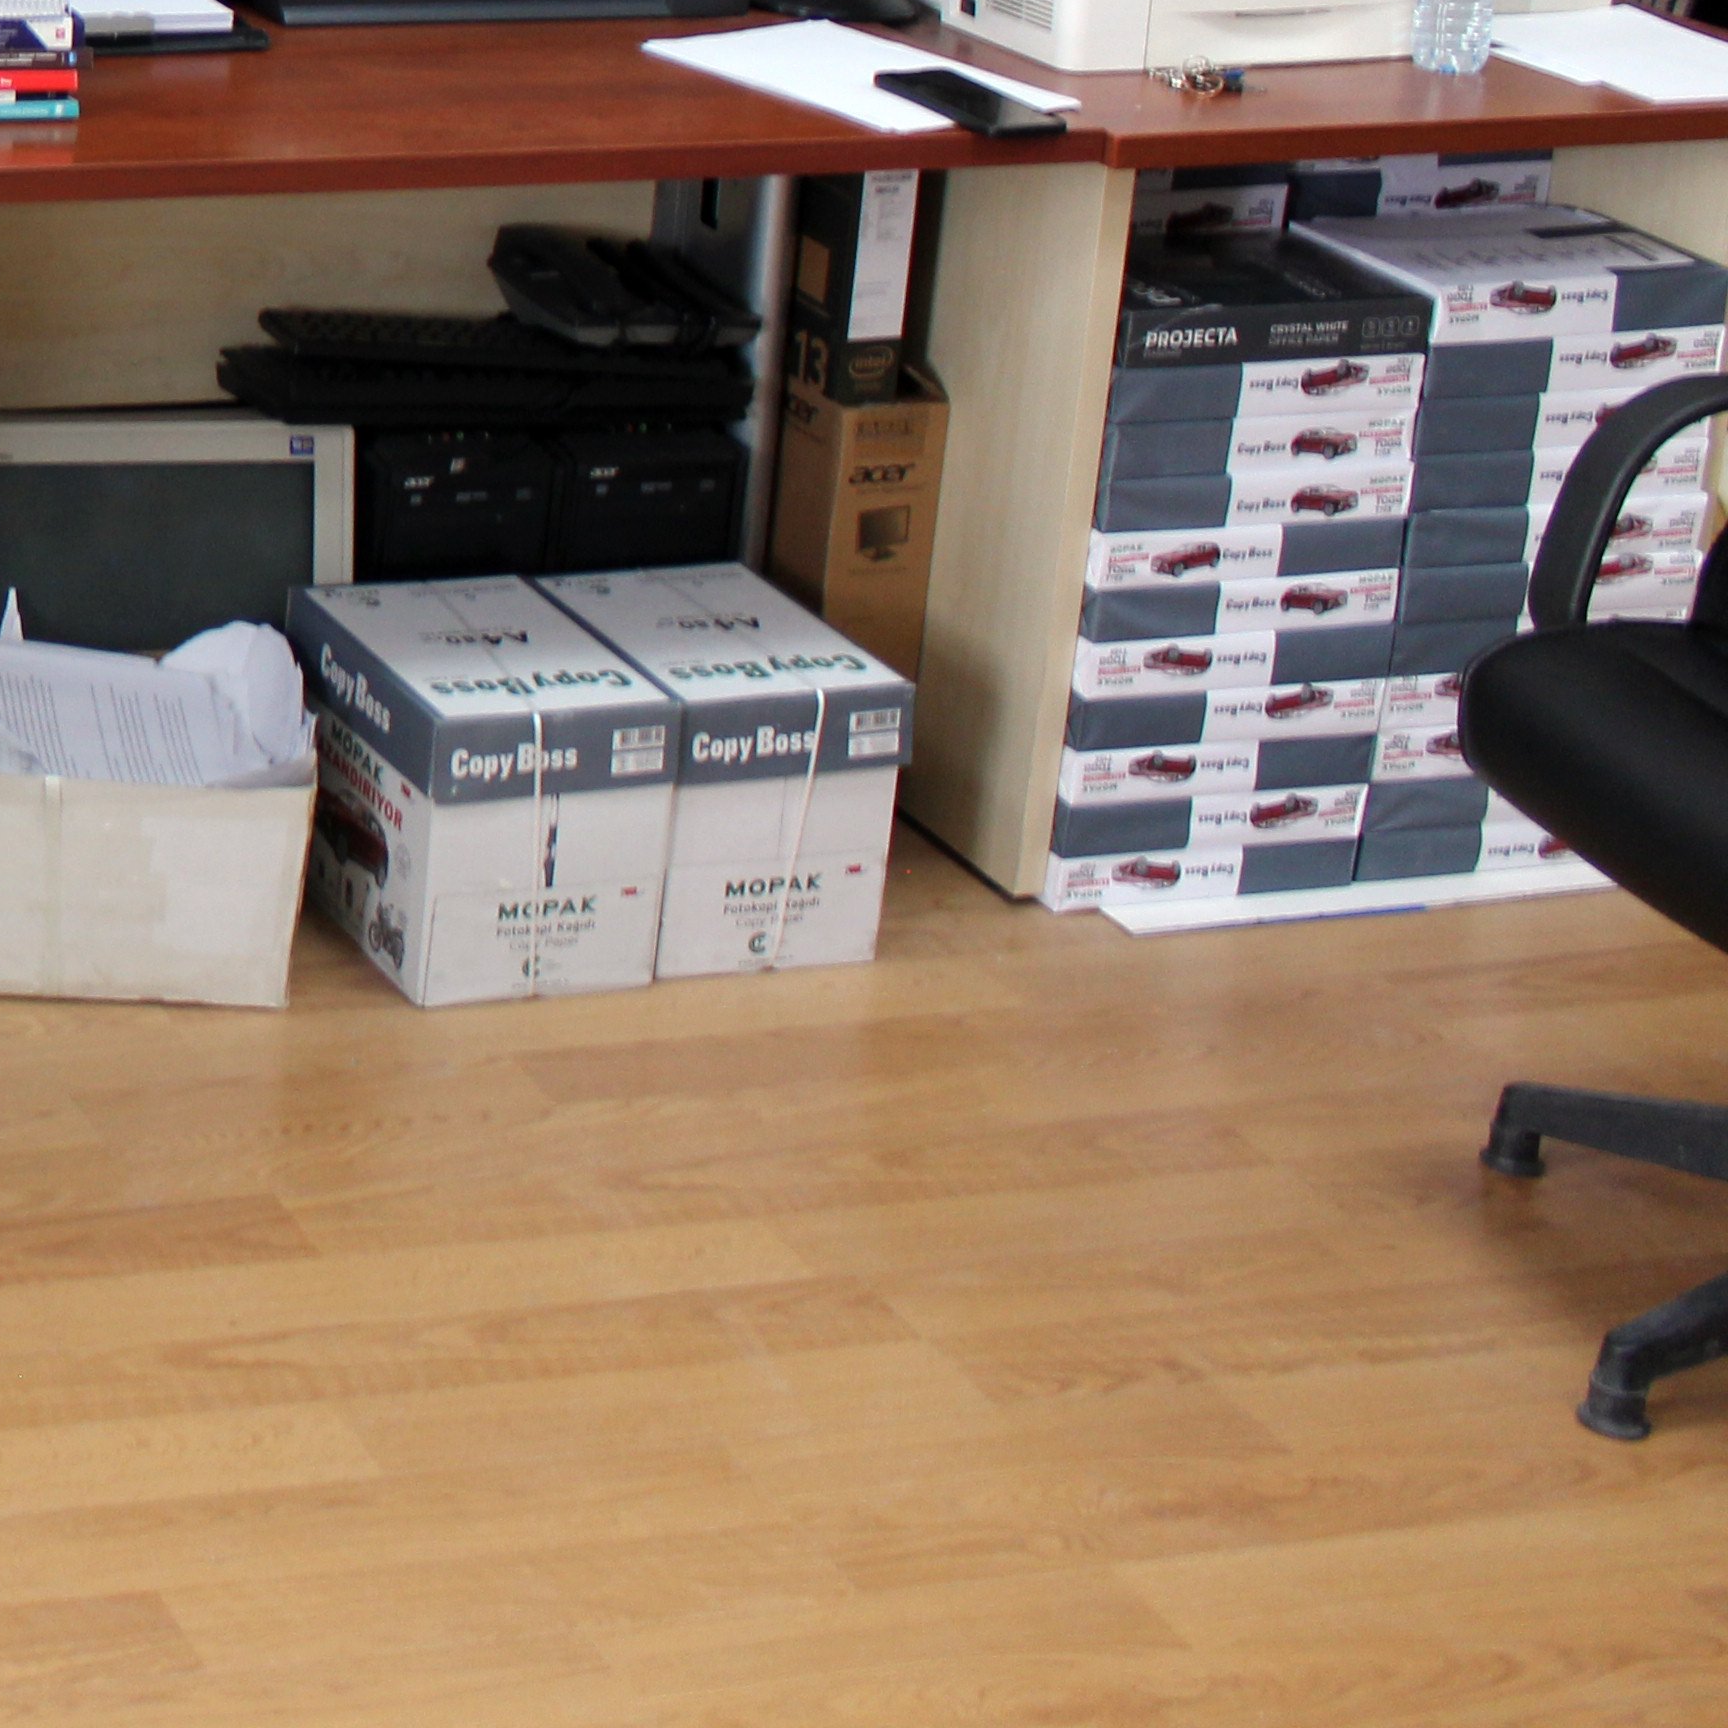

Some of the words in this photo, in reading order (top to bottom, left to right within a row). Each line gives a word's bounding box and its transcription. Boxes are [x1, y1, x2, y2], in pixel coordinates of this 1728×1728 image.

[1144, 326, 1239, 349] PROJECTA
[1270, 322, 1314, 333] CRYSTAL
[1315, 320, 1349, 332] WHITE
[849, 462, 915, 485] acer
[669, 660, 772, 678] Boss
[767, 654, 868, 671] Copy
[321, 642, 356, 706] Copy
[355, 672, 391, 735] Boss
[431, 675, 536, 696] Boss
[532, 669, 633, 688] Copy
[331, 719, 384, 787] MOPAK
[692, 731, 754, 765] Copy
[756, 725, 816, 758] Boss
[450, 747, 515, 783] Copy
[517, 742, 579, 772] Boss
[724, 873, 822, 898] MOPAK
[498, 894, 597, 920] MOPAK
[723, 900, 778, 915] Fotokopi
